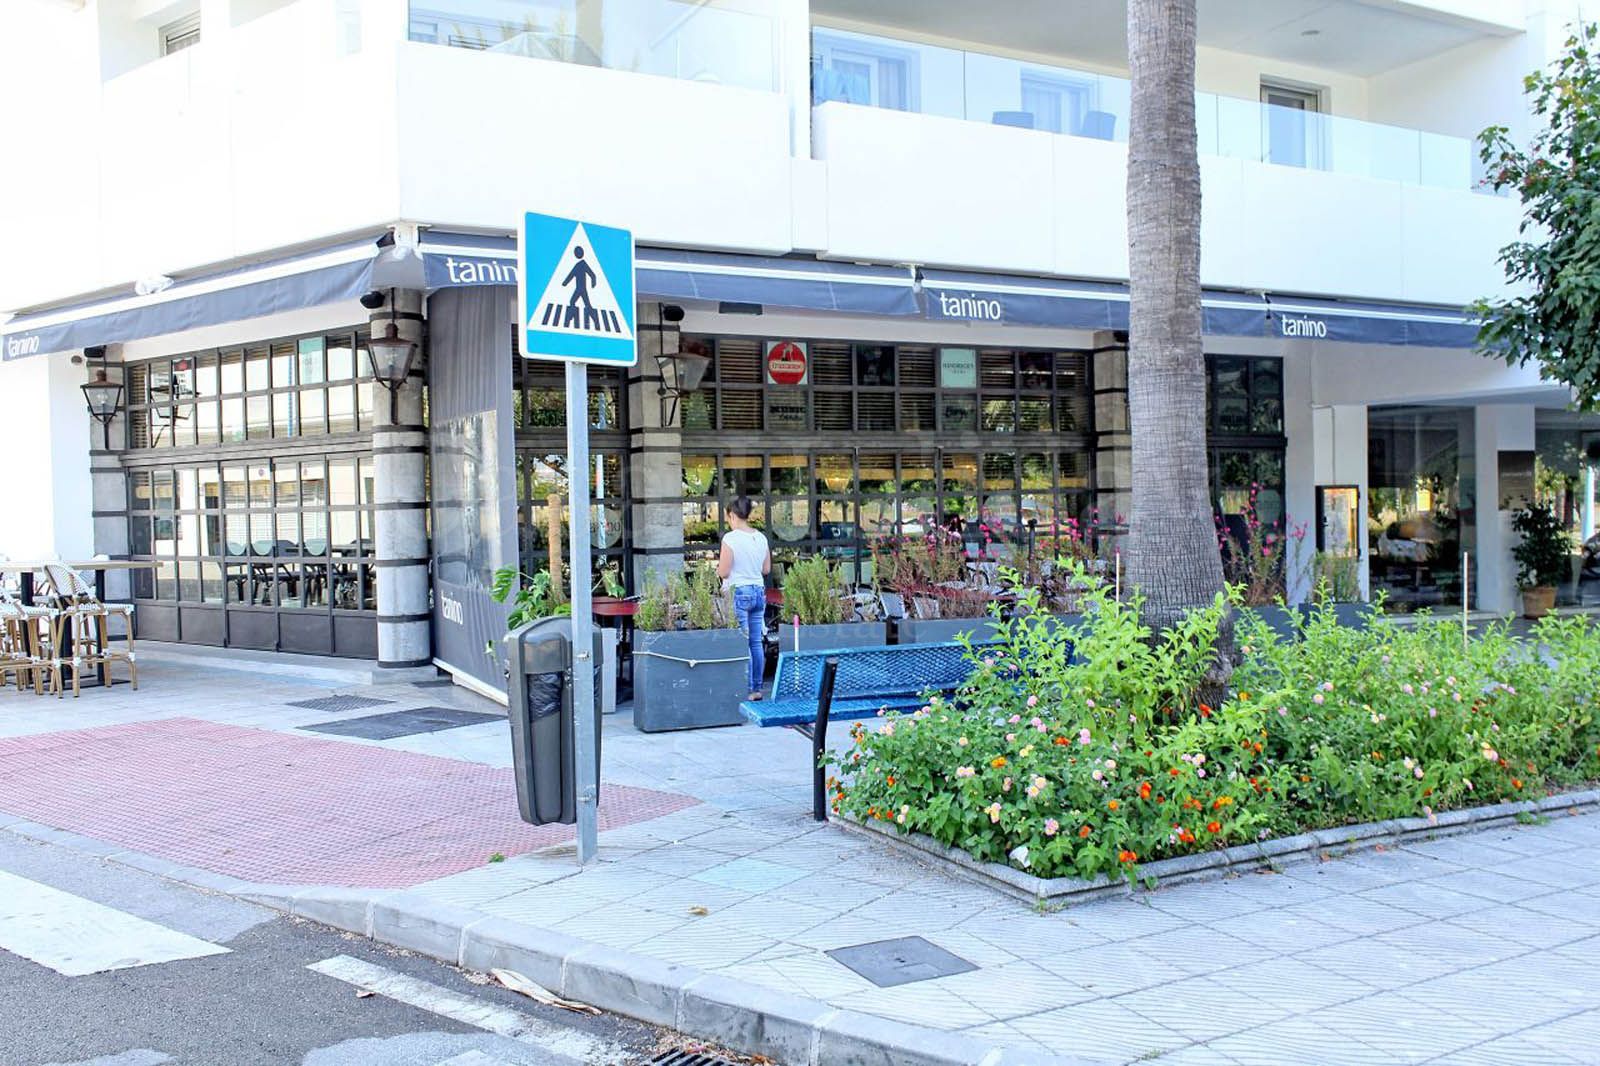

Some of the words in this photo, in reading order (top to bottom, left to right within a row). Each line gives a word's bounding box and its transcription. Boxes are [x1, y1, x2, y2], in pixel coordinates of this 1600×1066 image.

[446, 257, 517, 283] tanin
[940, 292, 1001, 320] tanino
[1281, 314, 1327, 338] tanino
[8, 332, 40, 357] tanino
[441, 590, 464, 625] tanino
